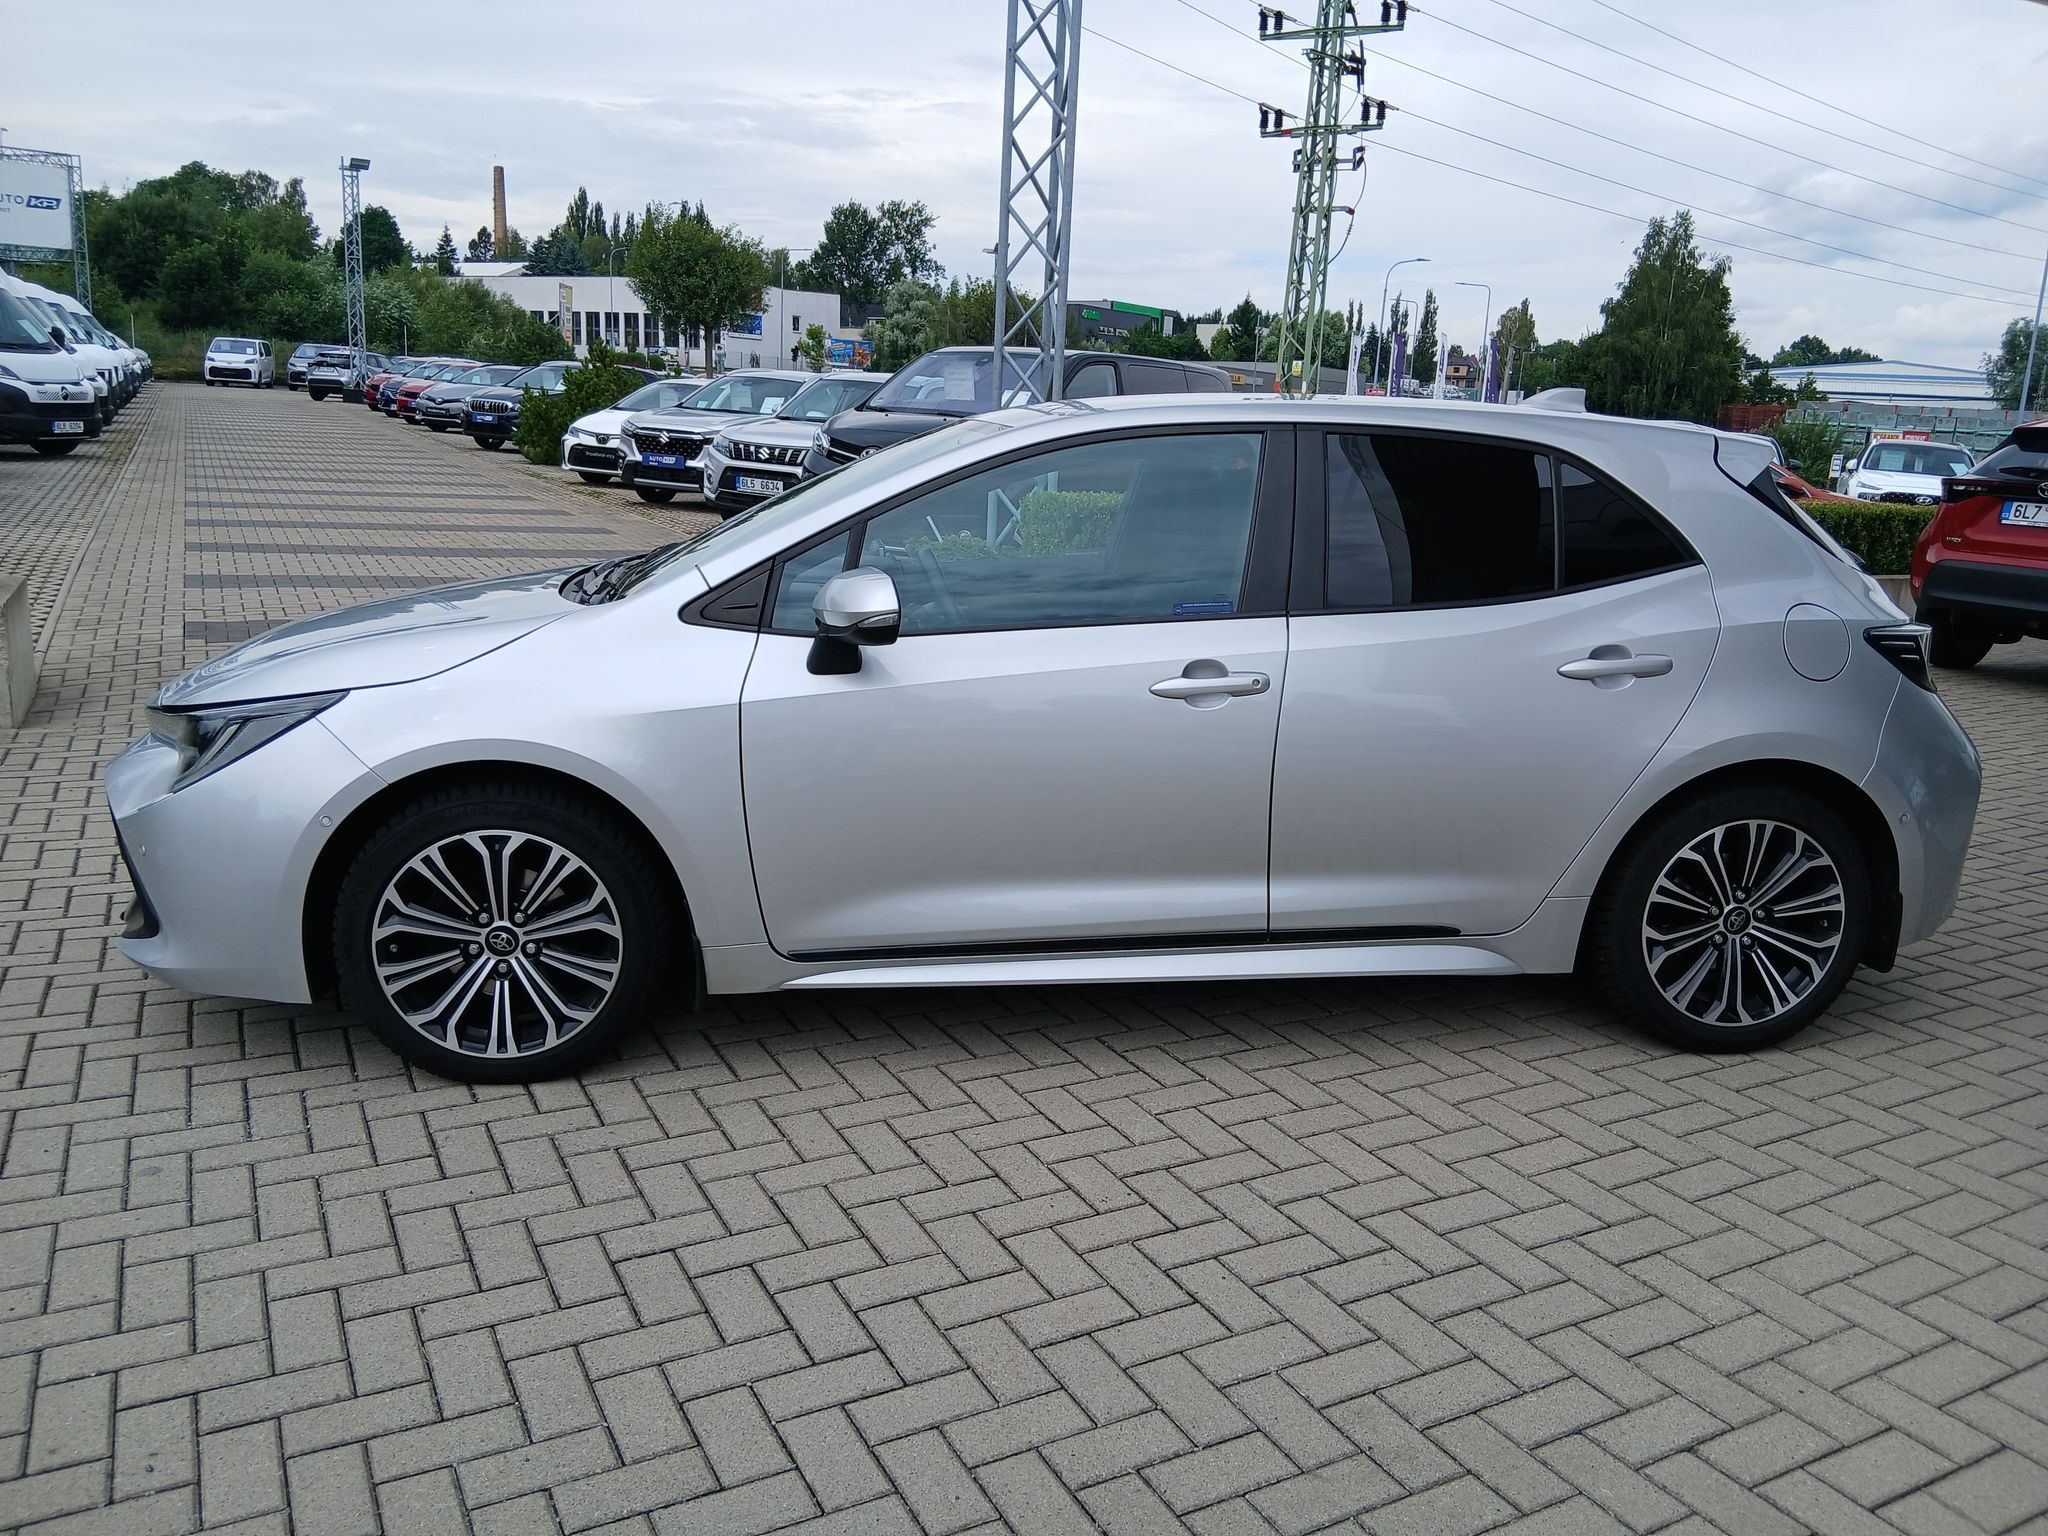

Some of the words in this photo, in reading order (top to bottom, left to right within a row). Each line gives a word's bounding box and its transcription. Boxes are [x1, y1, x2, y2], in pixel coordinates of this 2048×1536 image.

[741, 478, 755, 489] 6L5
[760, 480, 780, 491] 6634
[2013, 504, 2043, 520] 6L7
